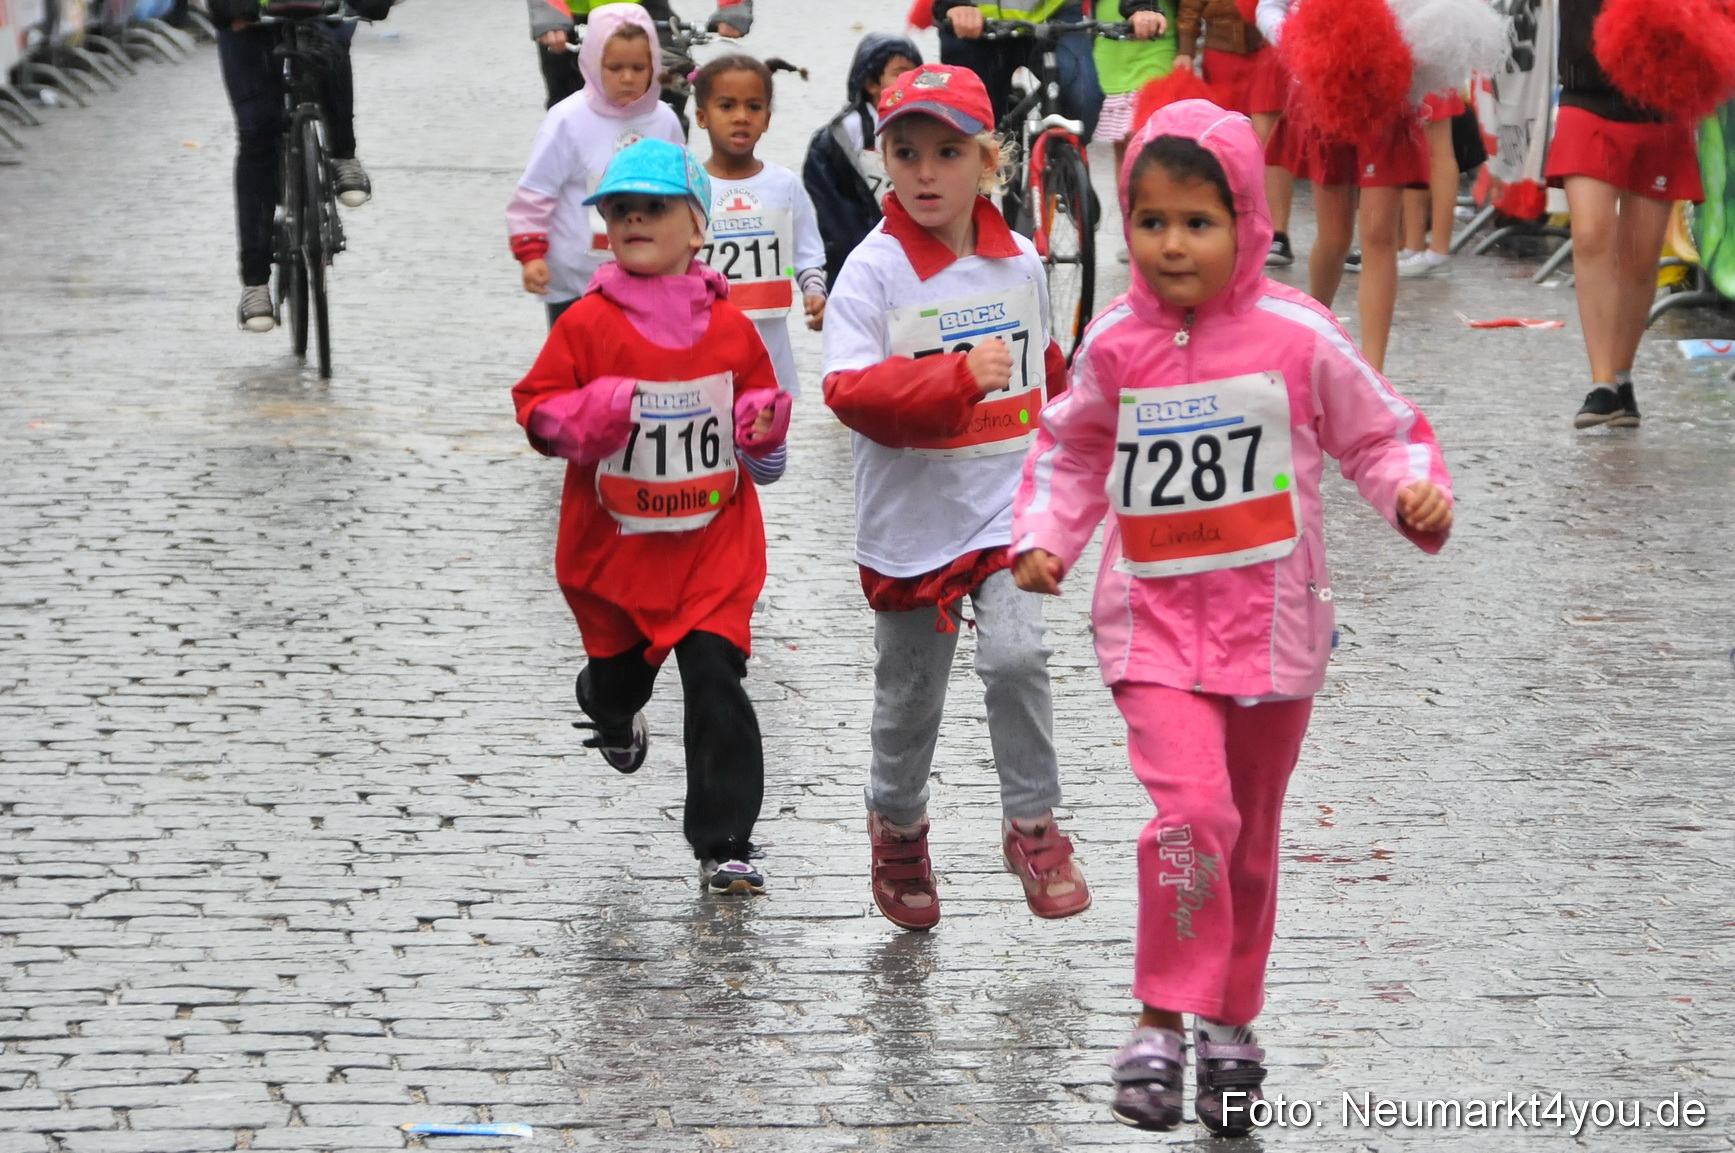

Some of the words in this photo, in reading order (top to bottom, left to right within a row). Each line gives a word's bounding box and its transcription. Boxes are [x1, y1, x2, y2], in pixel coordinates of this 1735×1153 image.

[717, 187, 759, 207] DEUTSCHES
[712, 216, 763, 232] BOCK
[702, 237, 780, 279] 7211
[939, 302, 1006, 331] BOCK
[639, 390, 702, 409] BOCK
[1136, 394, 1220, 424] BOCK
[621, 416, 720, 476] 7116
[1117, 424, 1264, 508] 7287
[636, 487, 708, 517] Sophie
[1150, 522, 1222, 547] Linda
